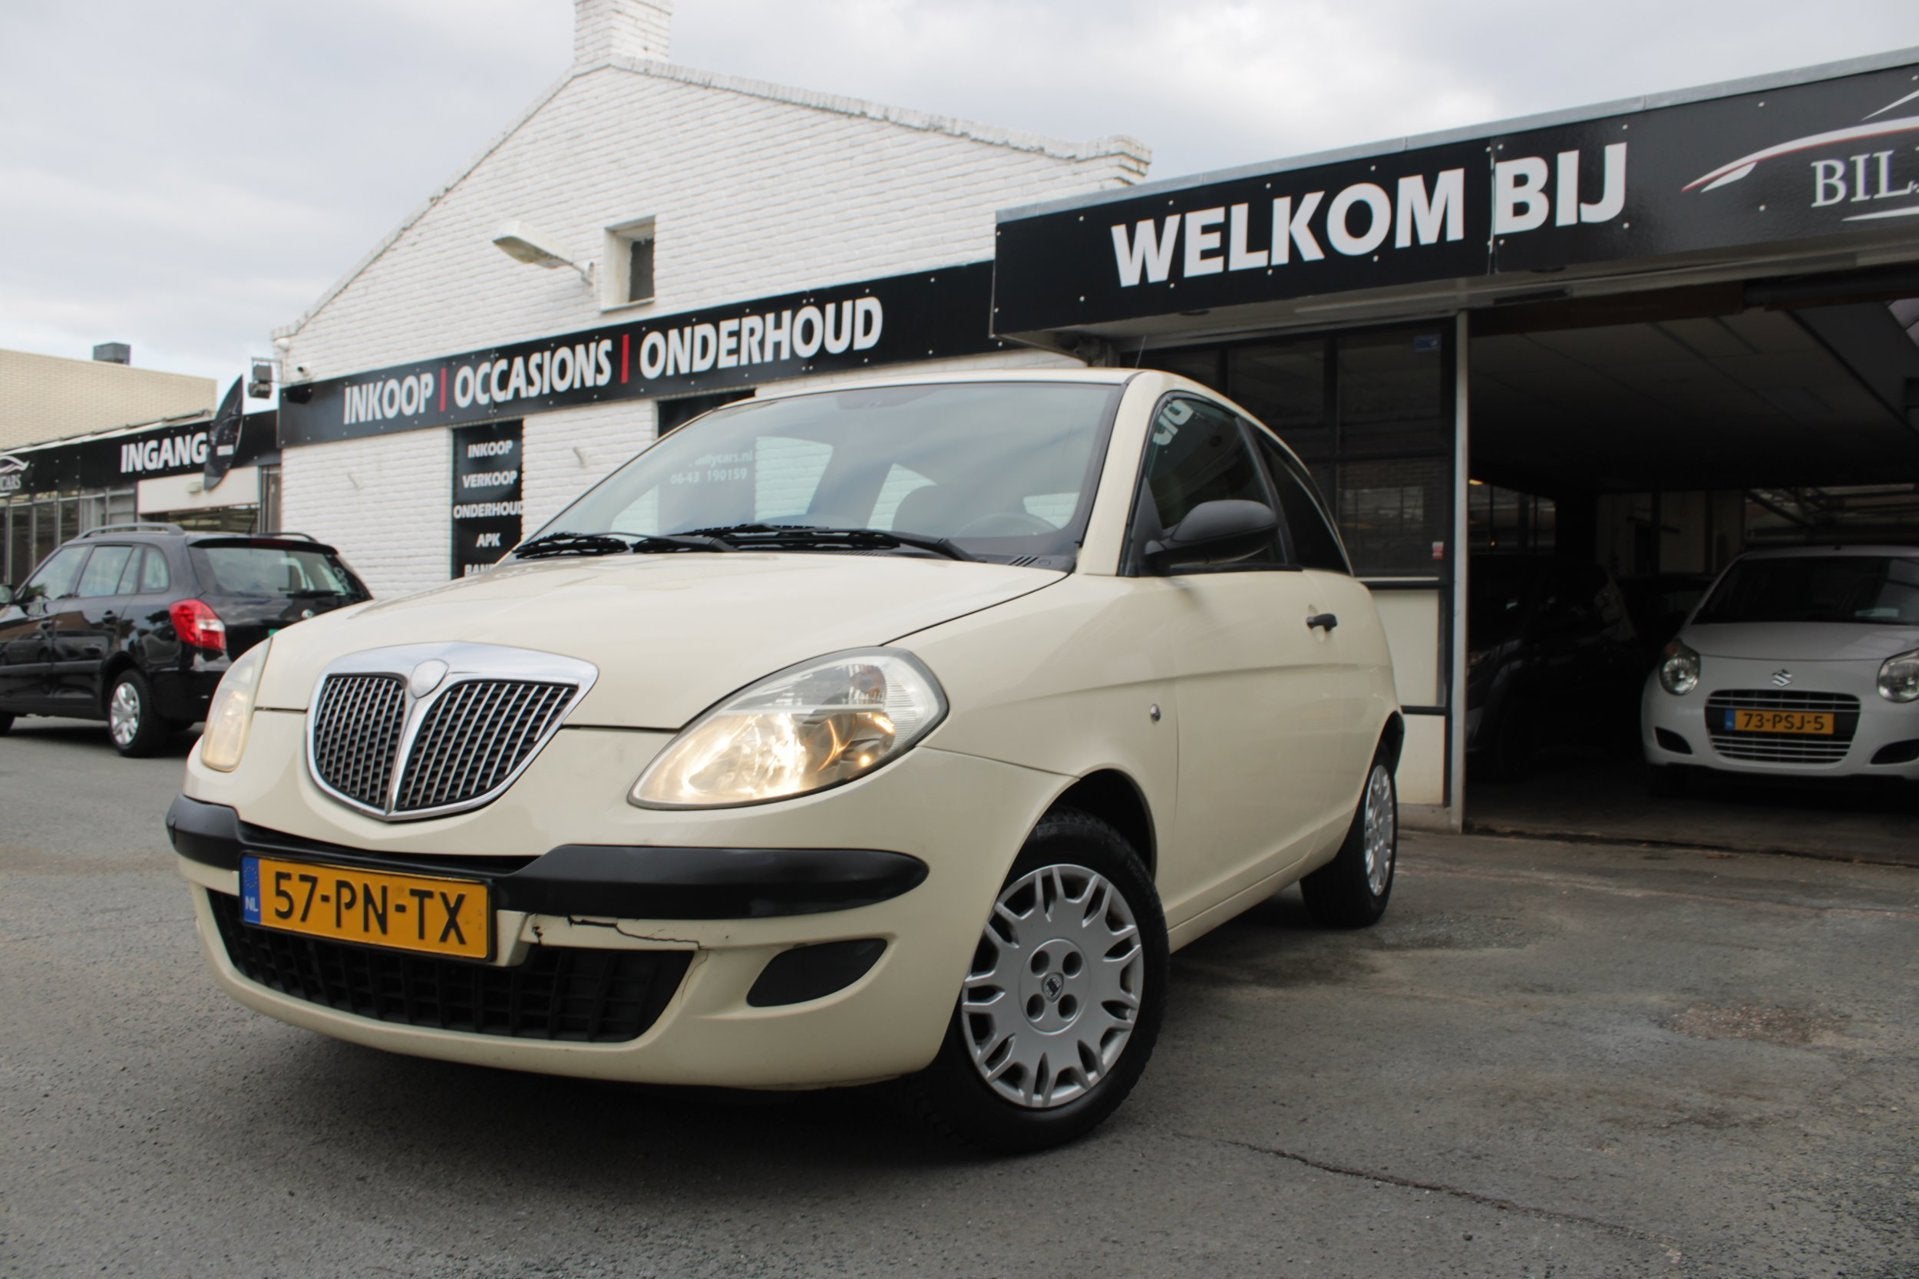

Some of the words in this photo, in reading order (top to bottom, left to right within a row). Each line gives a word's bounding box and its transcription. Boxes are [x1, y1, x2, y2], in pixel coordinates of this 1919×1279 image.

[1810, 146, 1919, 208] BIL
[1110, 168, 1465, 288] WELKOM
[1494, 142, 1628, 236] BIJ
[342, 372, 435, 425] INKOOP
[454, 340, 612, 408] OCCASIONS
[639, 296, 883, 379] ONDERHOUD
[120, 432, 208, 474] INGANG
[467, 440, 513, 458] INKOOP
[462, 470, 518, 488] VERKOOP
[476, 532, 501, 547] APK
[1743, 713, 1824, 731] 73-PSJ-5
[245, 896, 259, 912] NL
[273, 870, 467, 945] 57-PN-TX
